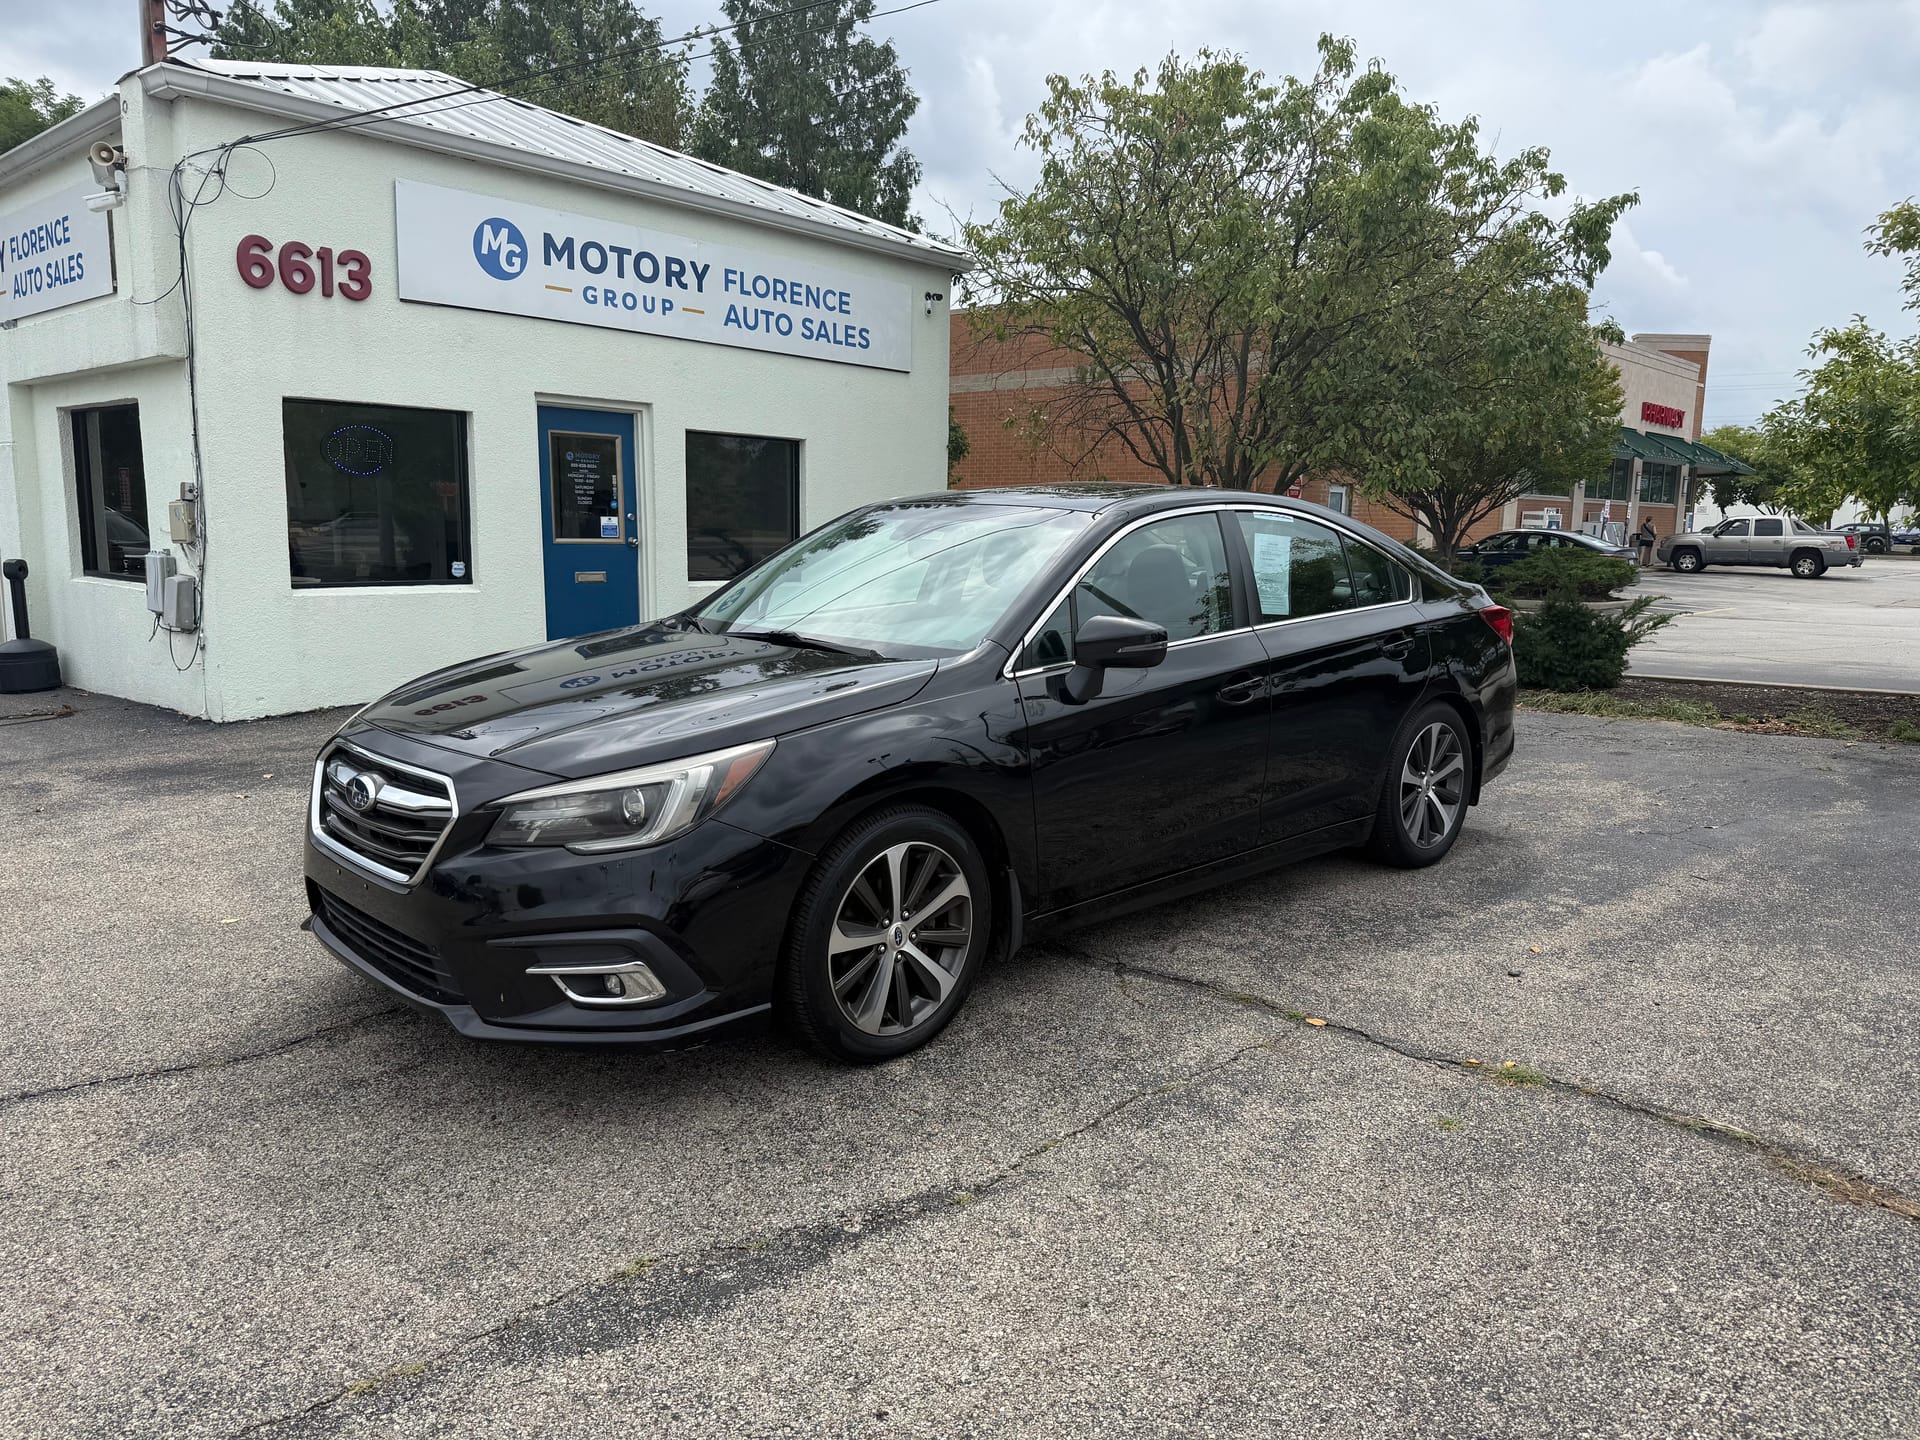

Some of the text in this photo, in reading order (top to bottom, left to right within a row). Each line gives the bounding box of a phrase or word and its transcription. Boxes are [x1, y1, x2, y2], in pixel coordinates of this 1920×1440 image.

[9, 215, 71, 264] FLORENCE
[481, 223, 522, 275] MG
[542, 232, 711, 293] MOTORY
[13, 252, 84, 300] AUTO SALES
[236, 234, 373, 301] 6613
[582, 285, 675, 316] GROUP
[723, 268, 852, 315] FLORENCE
[723, 304, 871, 350] AUTO SALES
[1640, 401, 1686, 429] PHARMACY
[327, 436, 394, 465] OPEN
